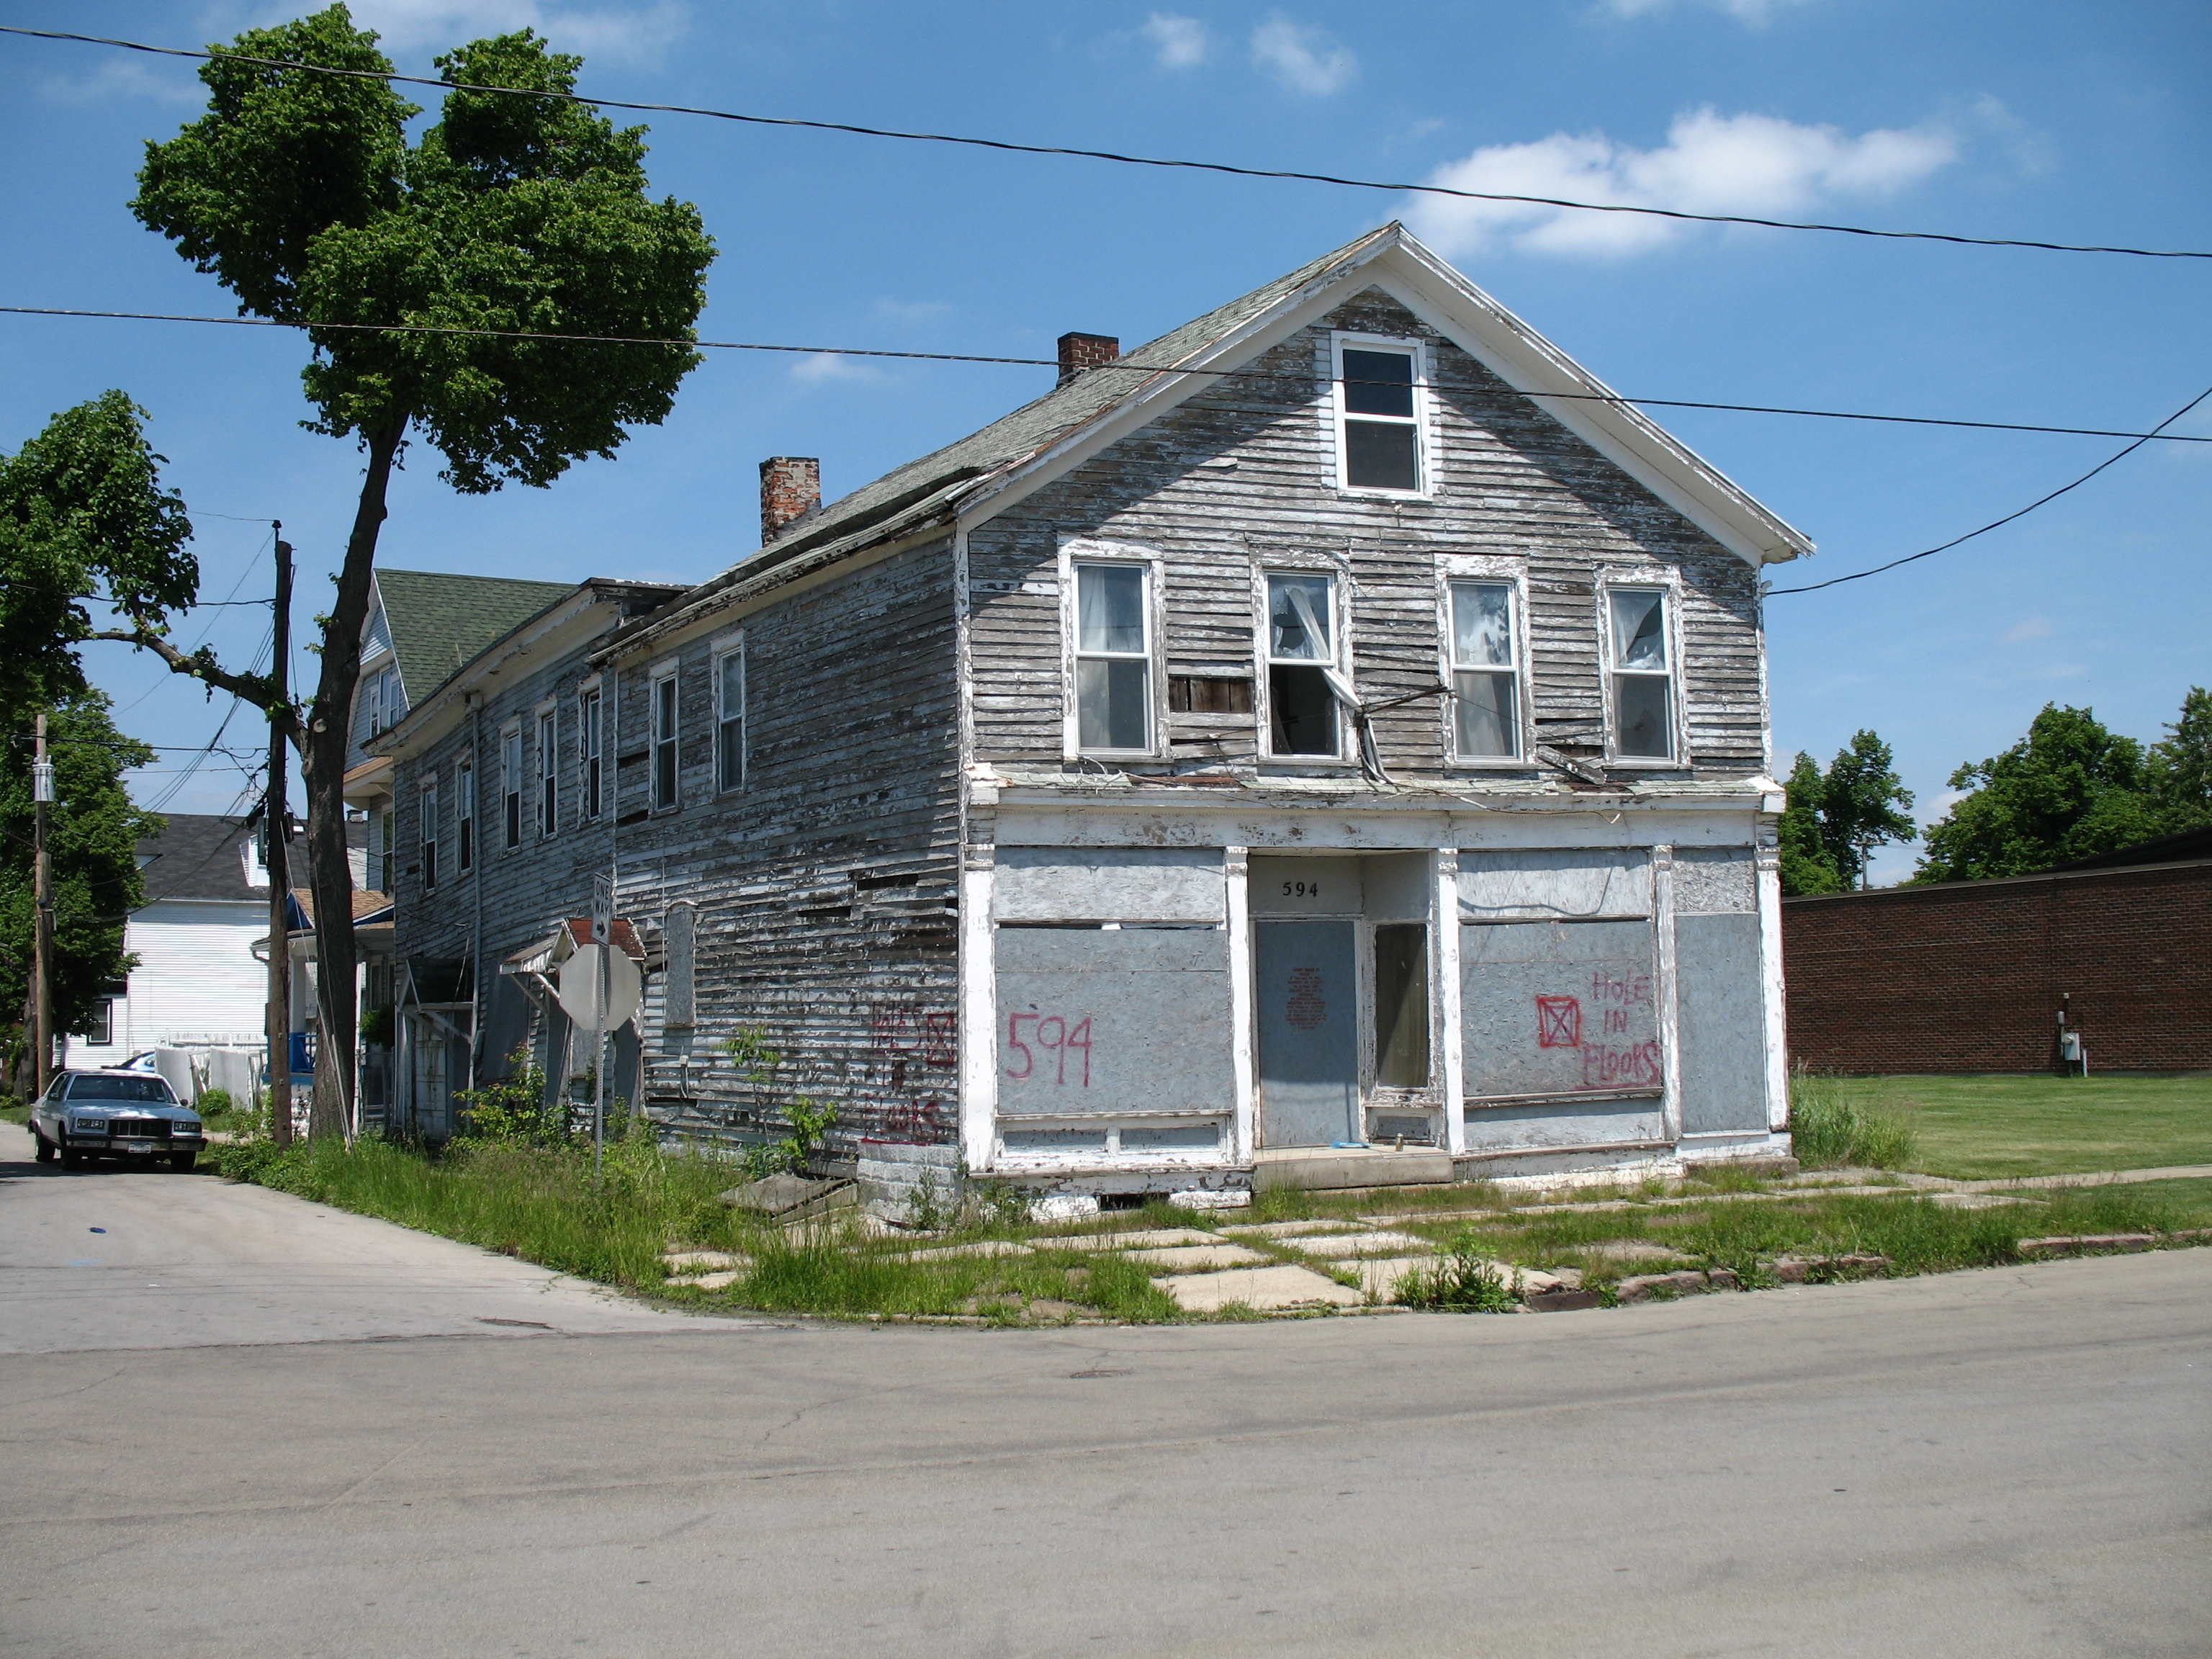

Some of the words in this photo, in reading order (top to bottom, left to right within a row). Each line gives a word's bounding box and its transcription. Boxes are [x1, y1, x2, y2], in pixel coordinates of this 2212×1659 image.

[595, 880, 609, 900] ONE
[1282, 881, 1318, 898] 594
[595, 899, 609, 918] WAY
[1604, 1009, 1628, 1035] IN
[1007, 1012, 1092, 1088] 594
